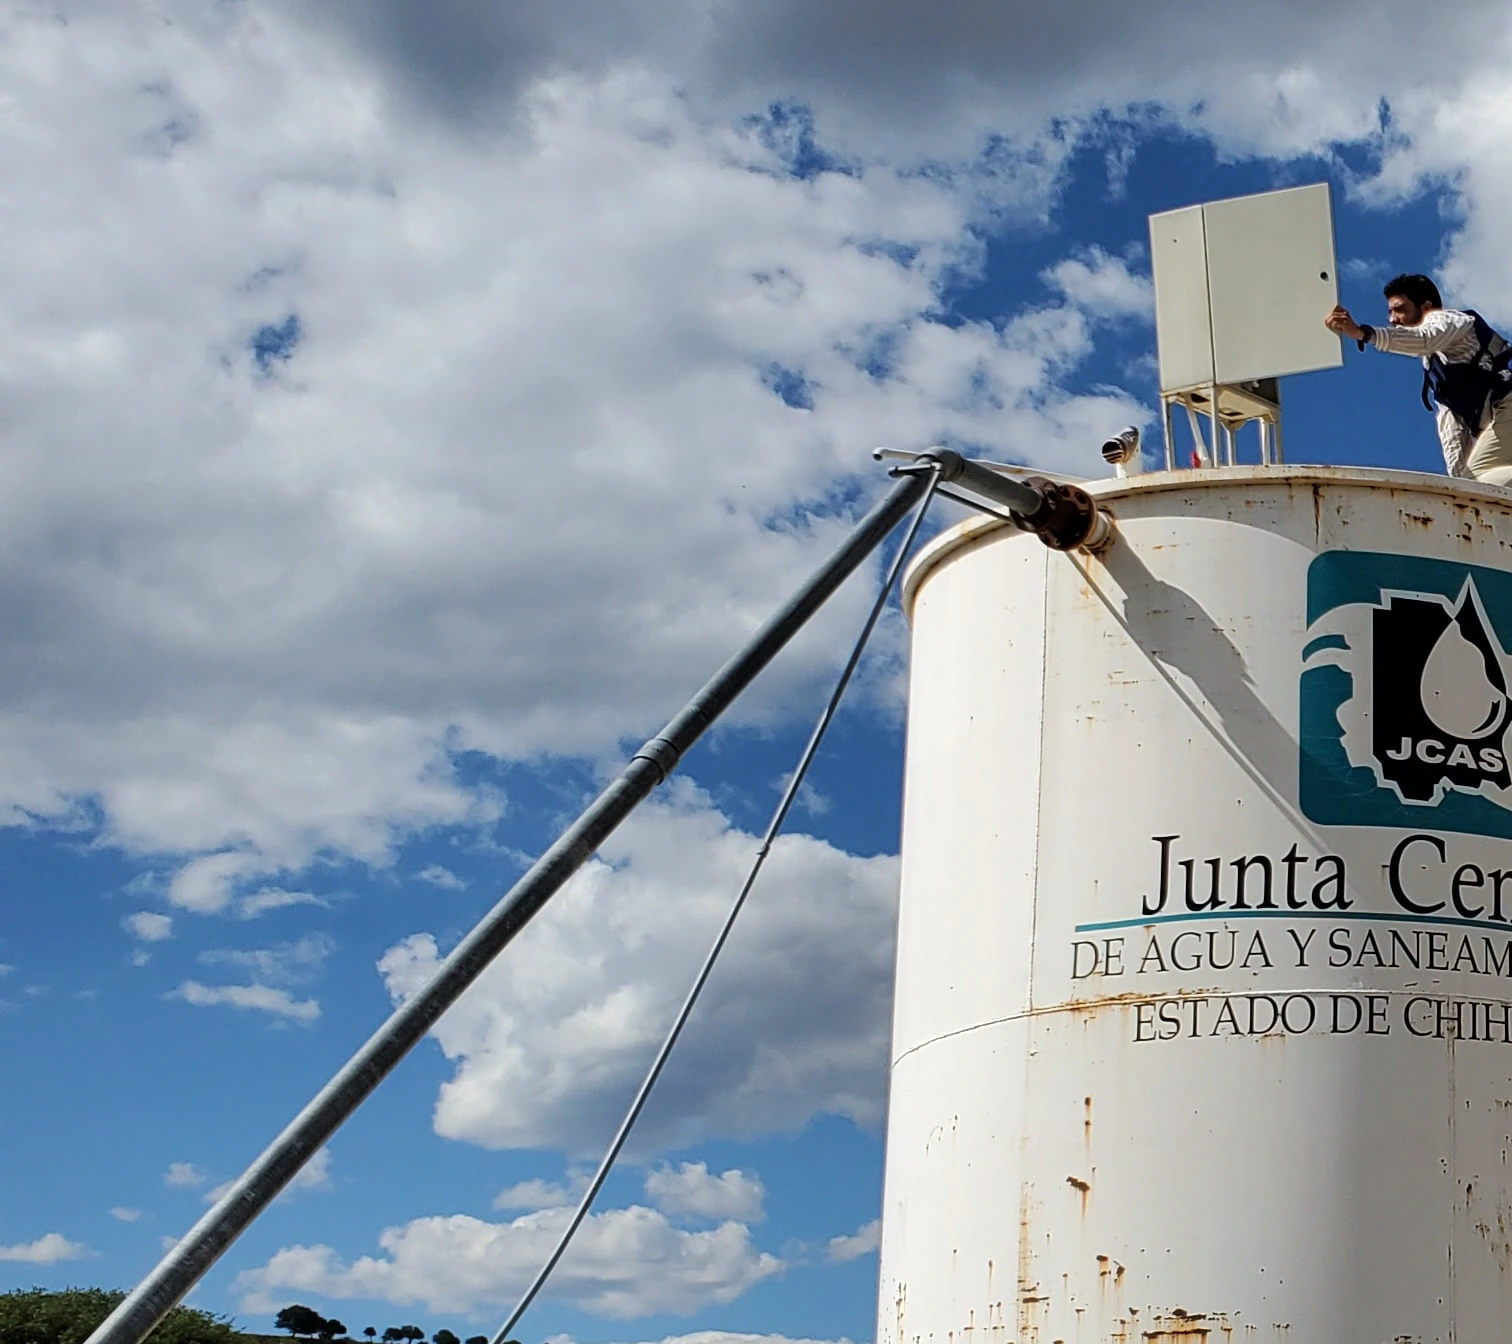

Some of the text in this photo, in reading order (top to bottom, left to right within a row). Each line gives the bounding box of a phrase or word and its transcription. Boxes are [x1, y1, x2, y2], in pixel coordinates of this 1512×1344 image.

[1386, 737, 1504, 773] JCAS
[1142, 835, 1354, 916] Junta
[1070, 938, 1125, 980] DE
[1136, 929, 1274, 974] AGUA
[1287, 928, 1316, 968] Y
[1132, 996, 1317, 1043] ESTADO
[1330, 996, 1391, 1035] DE
